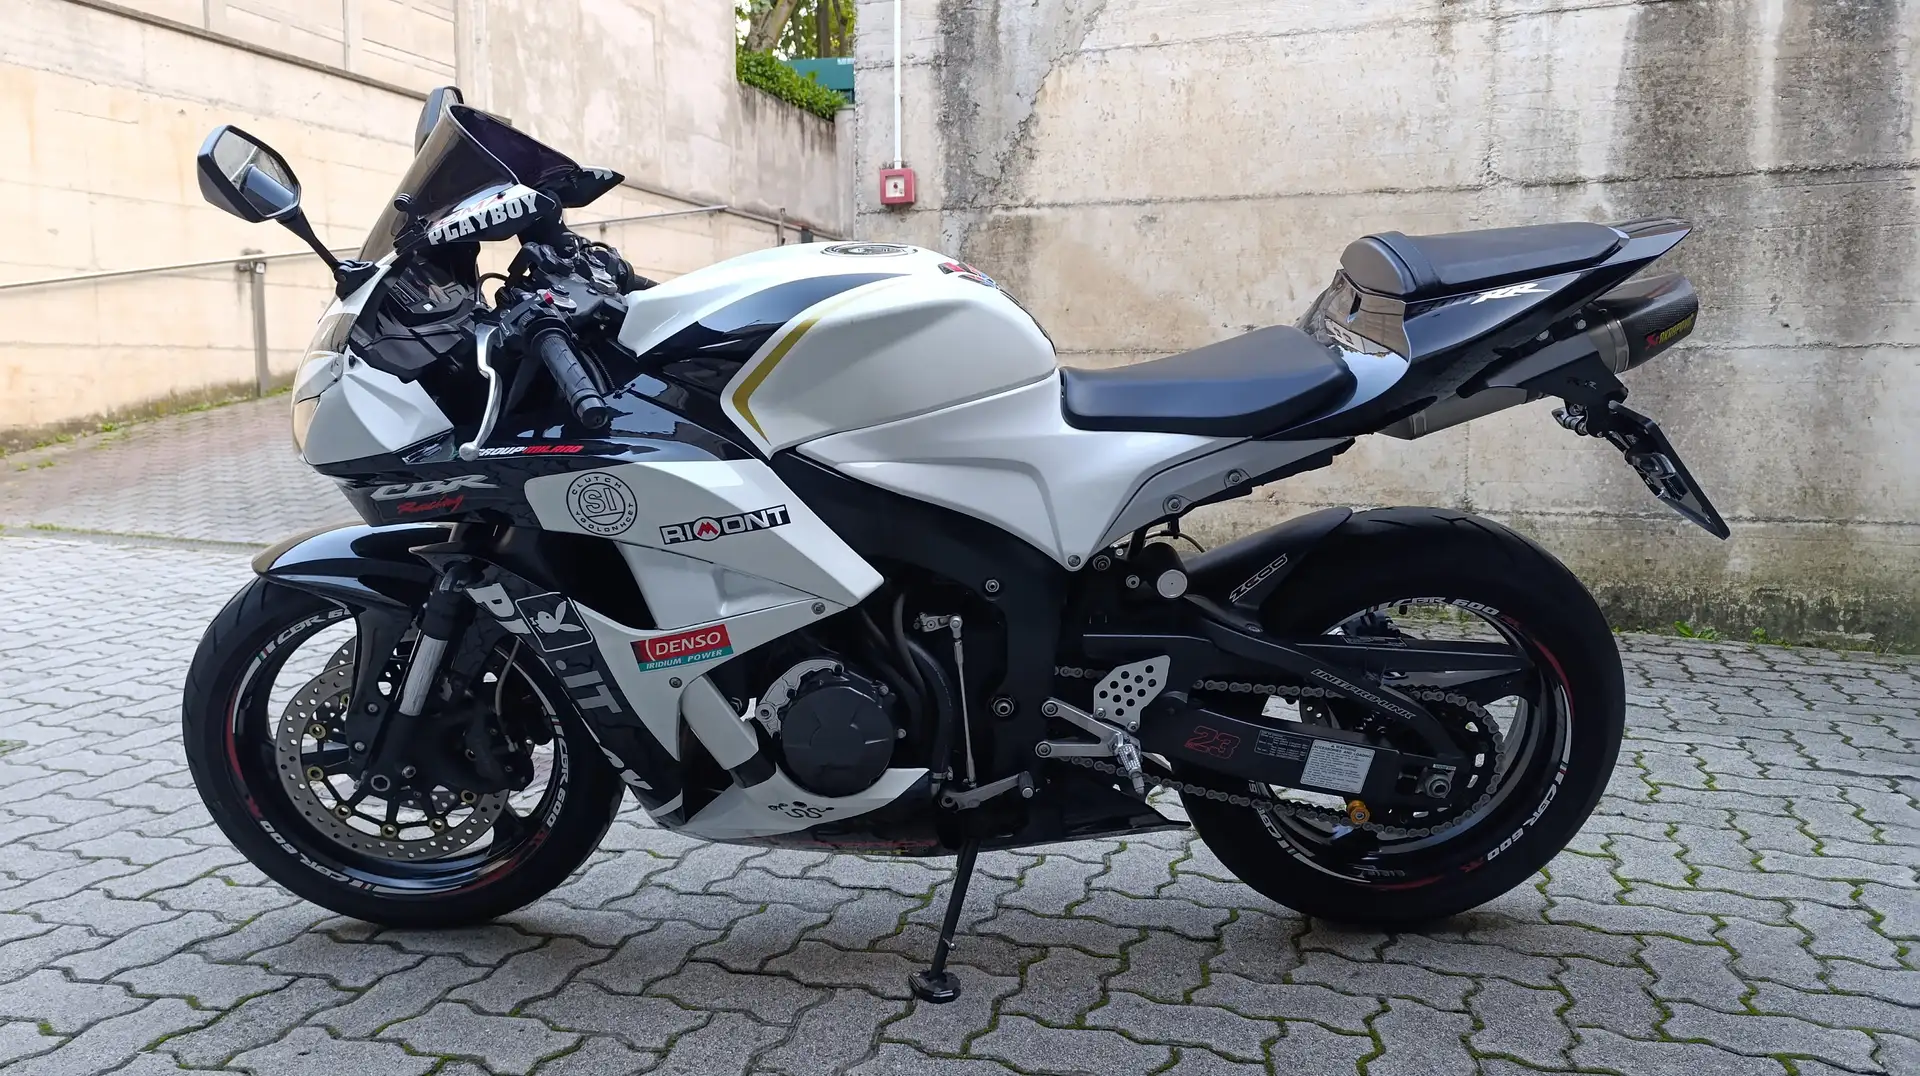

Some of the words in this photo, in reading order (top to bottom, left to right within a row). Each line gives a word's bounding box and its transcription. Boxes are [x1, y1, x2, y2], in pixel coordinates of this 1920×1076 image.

[427, 192, 538, 246] PLAYBOY
[371, 474, 499, 501] CBR
[571, 476, 622, 496] CLUTCH
[583, 487, 617, 514] SI
[660, 505, 786, 545] RIMONT
[1451, 598, 1500, 616] 600
[277, 614, 327, 645] CBR
[655, 632, 721, 656] DENSO
[646, 657, 682, 670] IRIDIUM
[687, 649, 723, 662] POWER
[558, 737, 569, 786] CBR
[546, 787, 567, 828] 600
[1522, 783, 1557, 827] CBR
[259, 820, 299, 855] 600
[1487, 827, 1524, 861] 600
[300, 852, 351, 882] CBR
